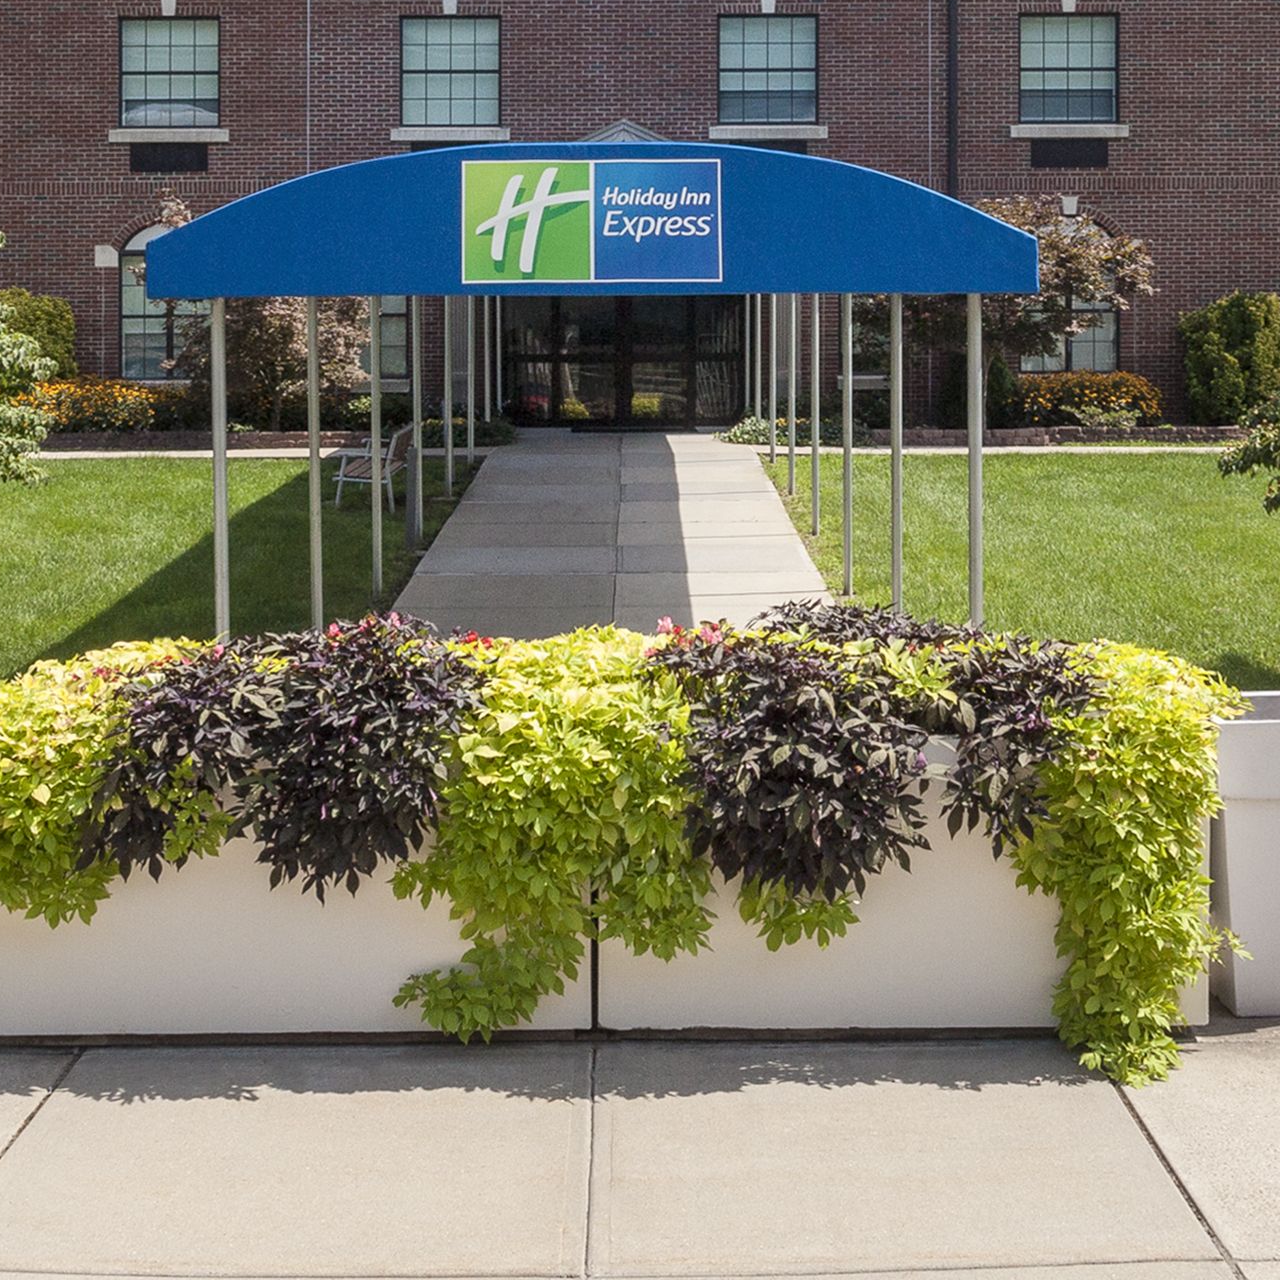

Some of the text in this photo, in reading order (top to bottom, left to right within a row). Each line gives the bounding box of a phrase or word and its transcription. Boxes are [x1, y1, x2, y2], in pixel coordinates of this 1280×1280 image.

[601, 186, 711, 210] Holiday Inn
[602, 210, 712, 243] Express
